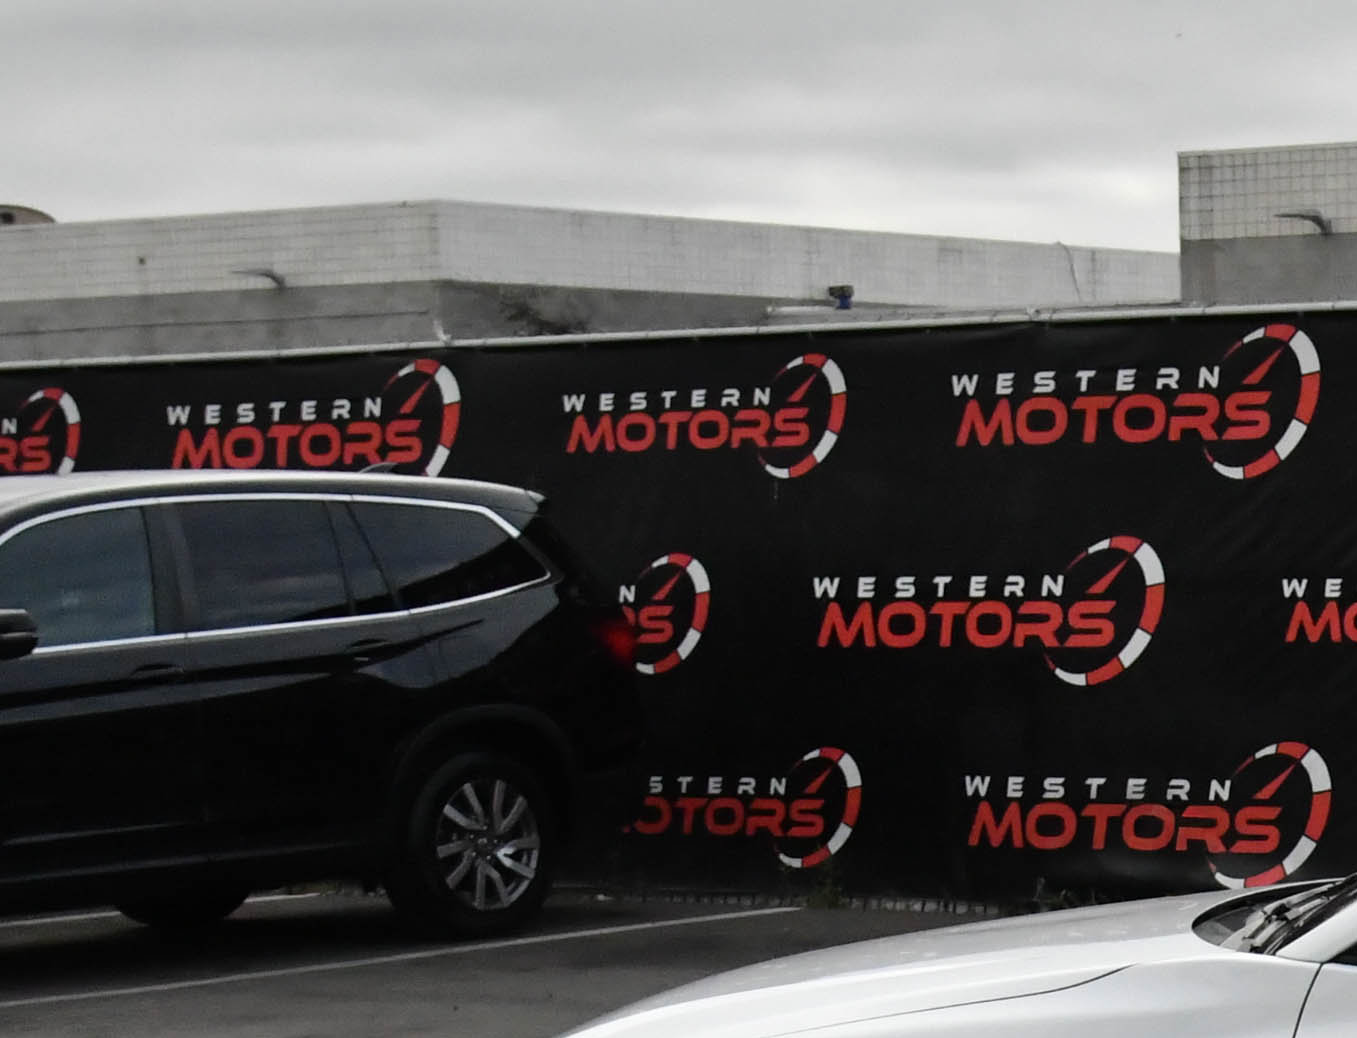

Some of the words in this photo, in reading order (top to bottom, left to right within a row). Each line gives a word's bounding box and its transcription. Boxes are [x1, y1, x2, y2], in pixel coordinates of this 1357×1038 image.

[952, 365, 1220, 396] WESTERN
[166, 397, 382, 425] WESTERN
[563, 387, 771, 413] WESTERN
[566, 408, 810, 453] MOTORS
[955, 390, 1272, 447] MOTORS
[171, 419, 423, 469] MOTORS
[813, 574, 1065, 599] WESTERN
[816, 600, 1117, 649] MOTORS
[649, 776, 787, 795] STERN
[964, 775, 1233, 802] WESTERN
[623, 796, 825, 837] OTORS
[967, 802, 1282, 854] MOTORS
